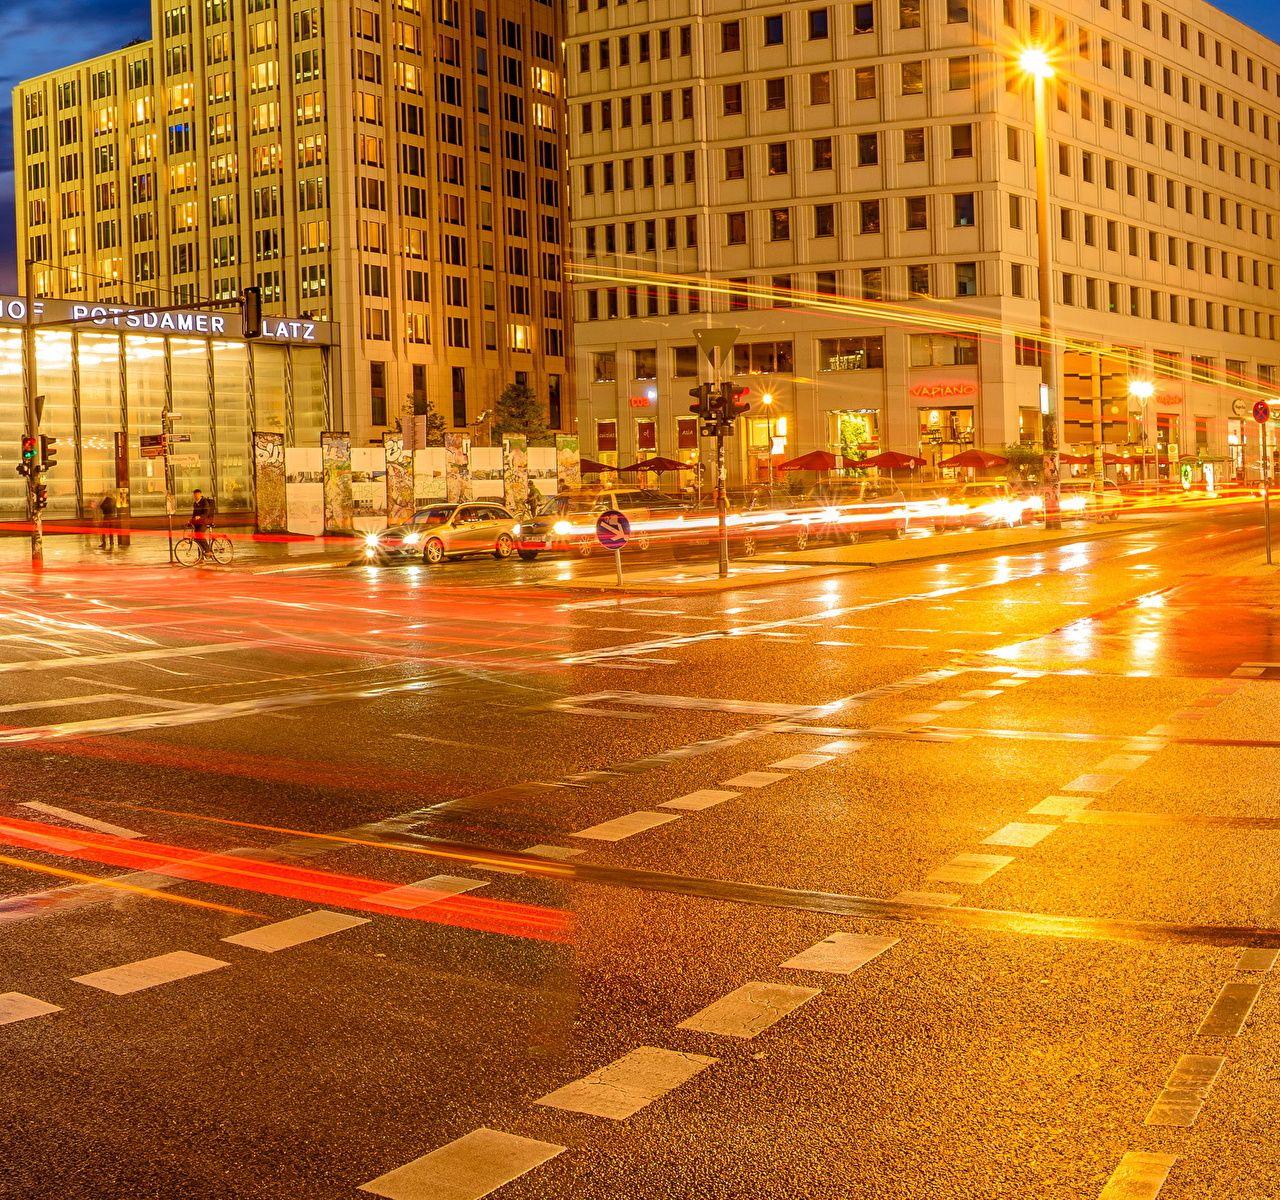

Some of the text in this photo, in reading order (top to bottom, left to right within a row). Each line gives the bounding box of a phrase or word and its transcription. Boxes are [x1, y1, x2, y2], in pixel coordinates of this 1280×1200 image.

[72, 304, 225, 333] POTSDAMER
[261, 320, 315, 340] LATZ
[910, 384, 976, 397] VAPIANO
